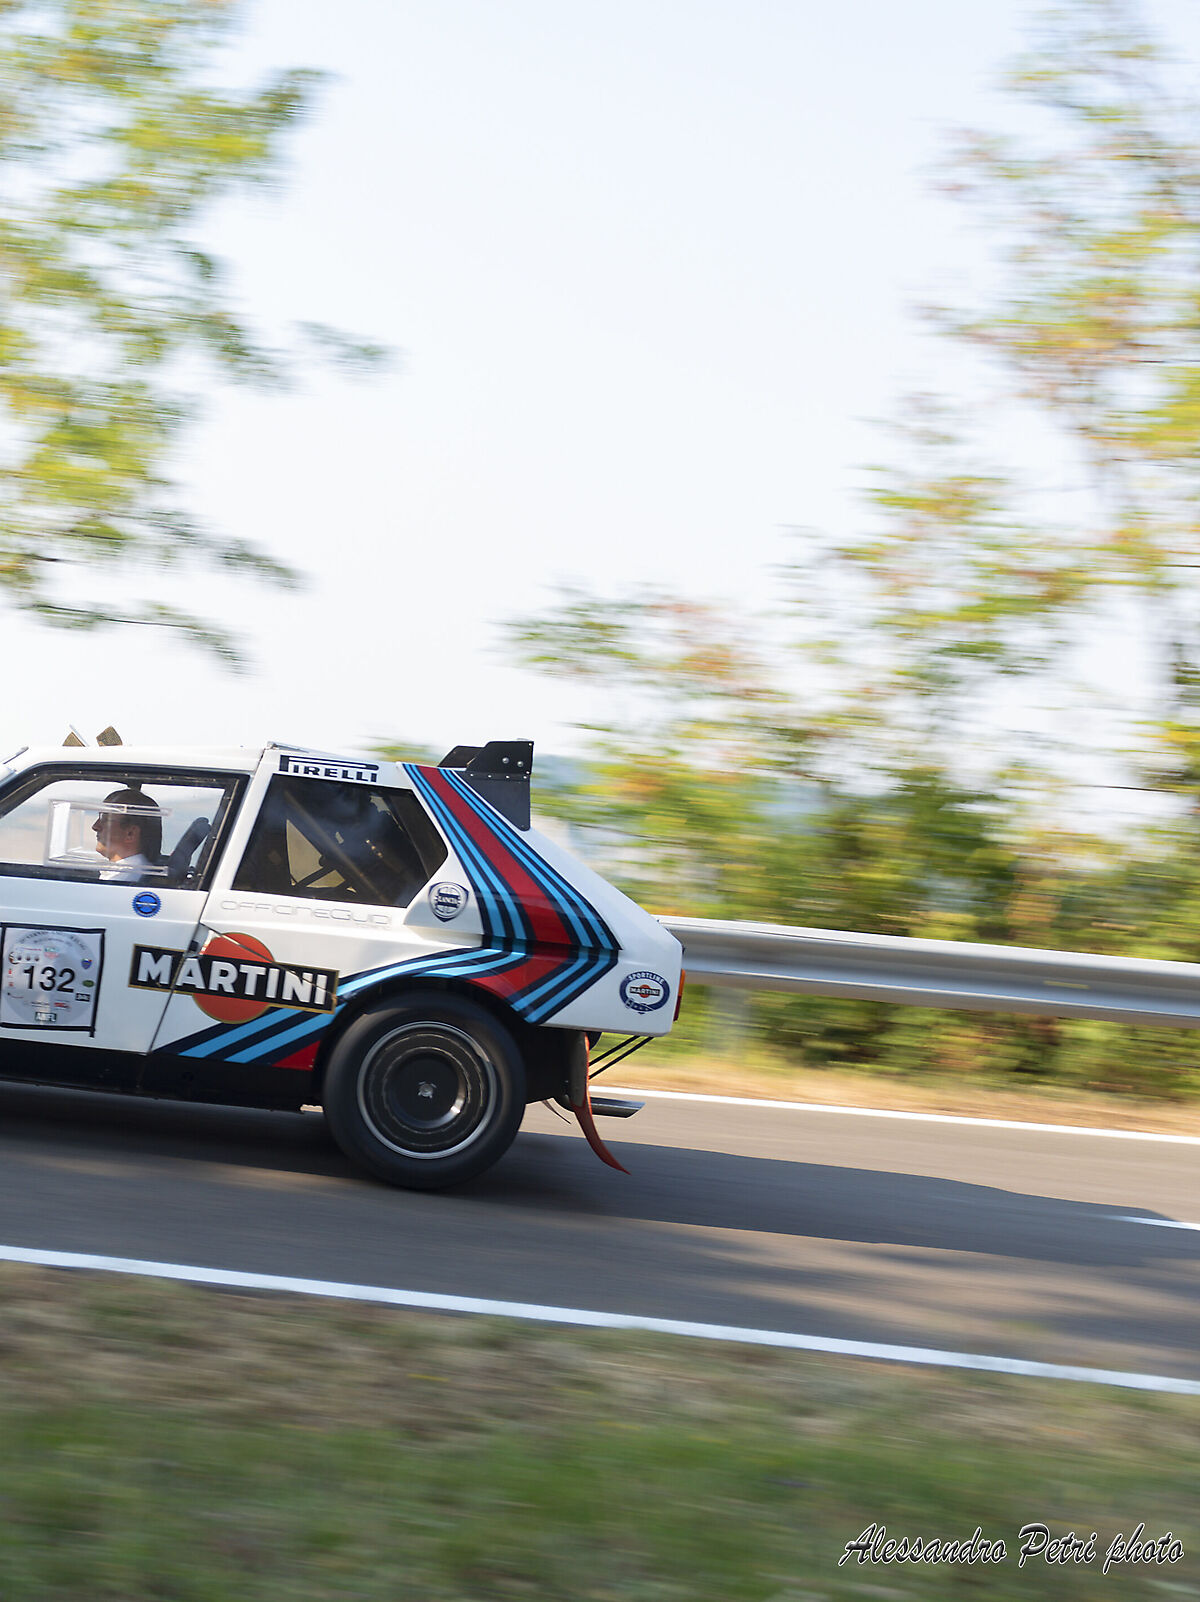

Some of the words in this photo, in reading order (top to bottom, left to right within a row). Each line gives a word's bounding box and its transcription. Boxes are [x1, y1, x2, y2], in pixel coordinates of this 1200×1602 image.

[280, 755, 379, 783] PIRELLI
[23, 966, 75, 993] 132
[137, 952, 328, 1005] MARTINI
[628, 972, 664, 985] SPORTLINE
[630, 987, 660, 995] MARTINI
